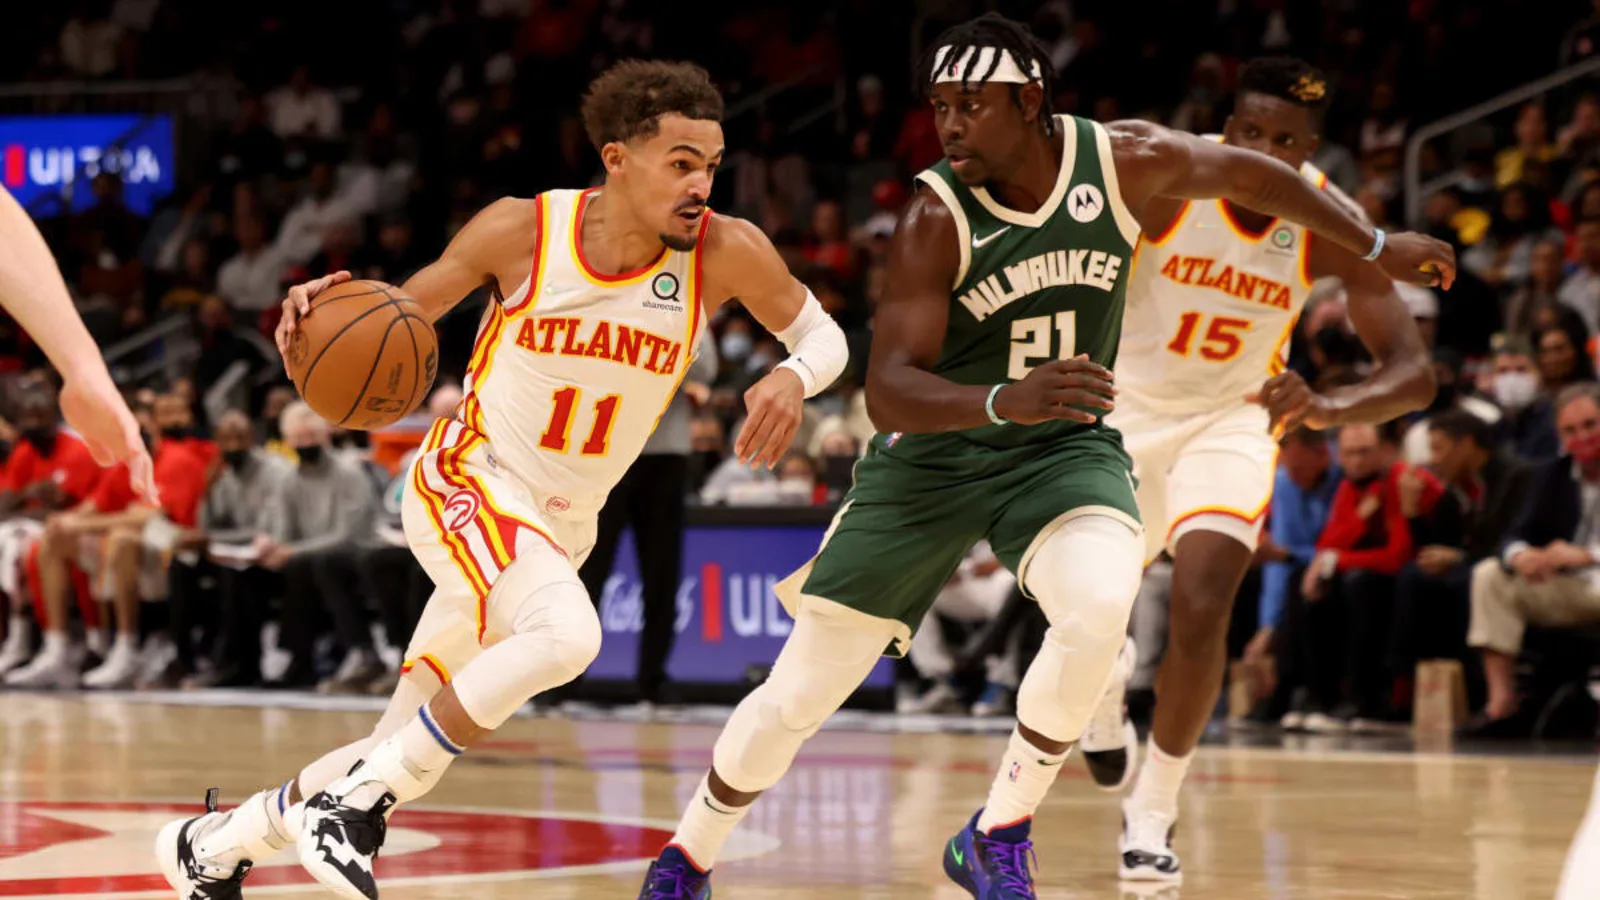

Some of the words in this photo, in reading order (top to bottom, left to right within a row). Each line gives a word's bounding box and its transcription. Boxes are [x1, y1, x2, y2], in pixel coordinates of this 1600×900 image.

[642, 300, 684, 313] sharecare
[958, 249, 1122, 322] MILWAUKEE
[1160, 253, 1292, 312] ATLANTA
[514, 315, 683, 376] ATLANTA
[1006, 310, 1077, 382] 21
[1167, 310, 1251, 363] 15
[538, 384, 623, 458] 11
